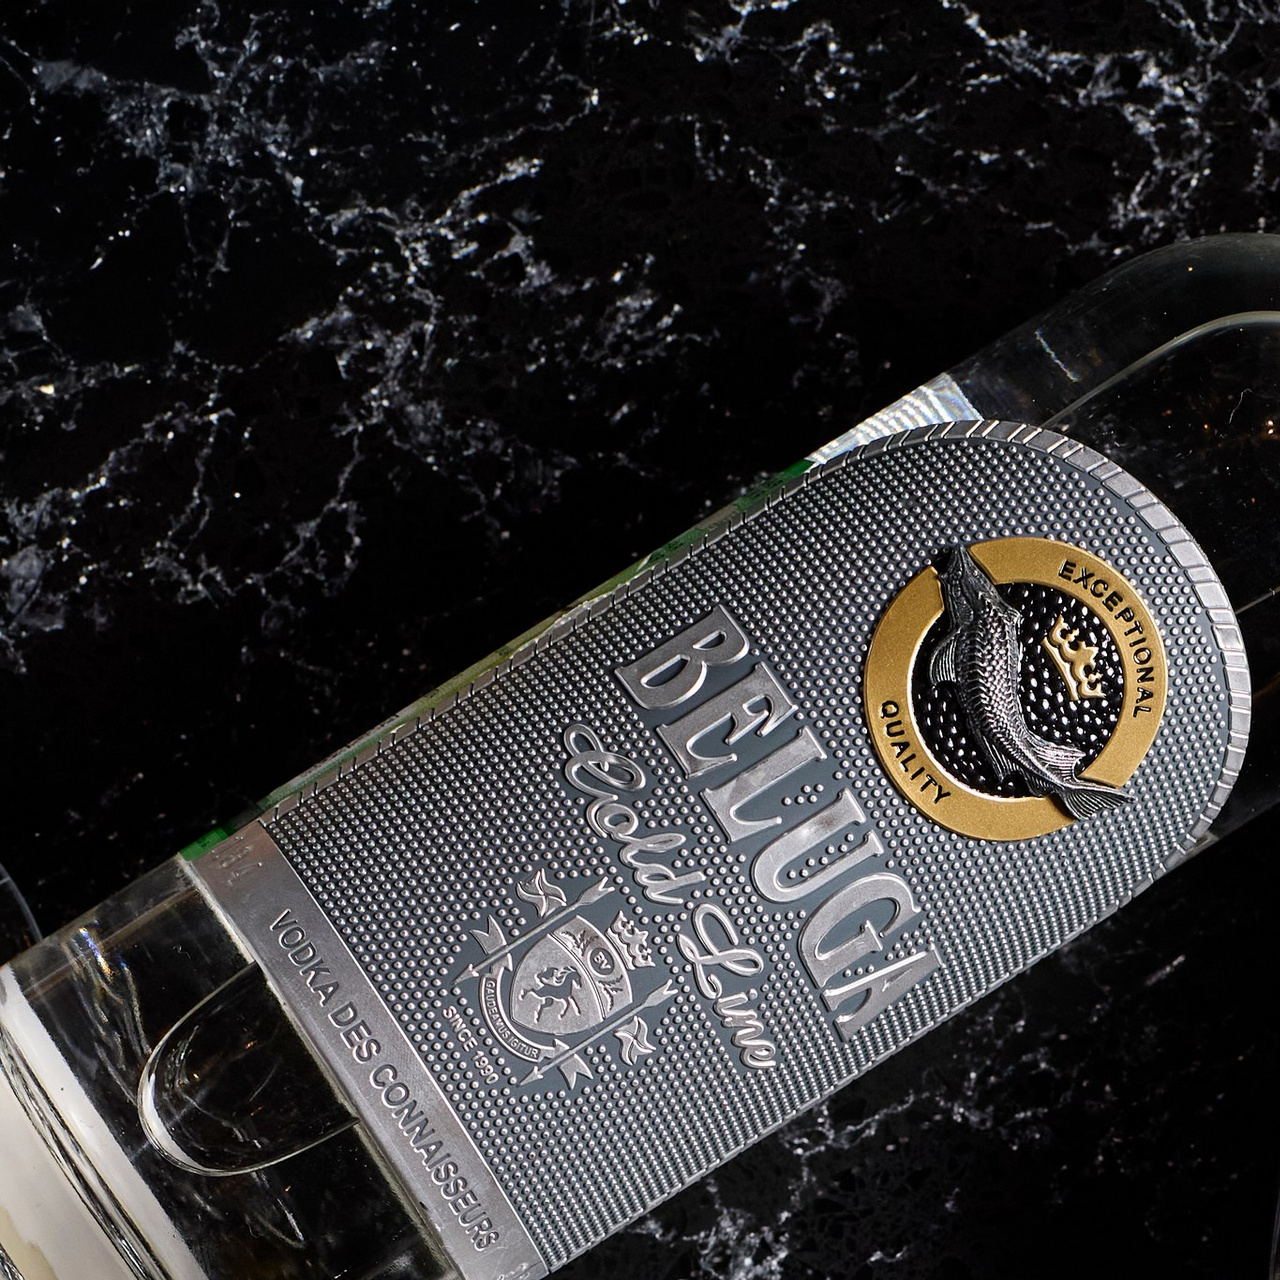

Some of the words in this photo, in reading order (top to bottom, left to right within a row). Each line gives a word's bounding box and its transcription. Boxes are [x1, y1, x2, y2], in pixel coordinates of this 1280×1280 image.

[1058, 560, 1154, 717] EXCEPTIONAL
[880, 700, 951, 804] QUALITY
[614, 603, 943, 1041] BELUGA
[484, 980, 511, 1039] GAUDEAMUS
[508, 1034, 540, 1058] IGITUR
[593, 951, 612, 971] BV
[678, 903, 777, 1069] Line
[269, 908, 341, 1007] VODKA
[328, 1001, 381, 1063] DES
[369, 1064, 500, 1251] CONNAISSEURS
[443, 1005, 478, 1052] SINCE
[472, 1051, 499, 1084] 1990
